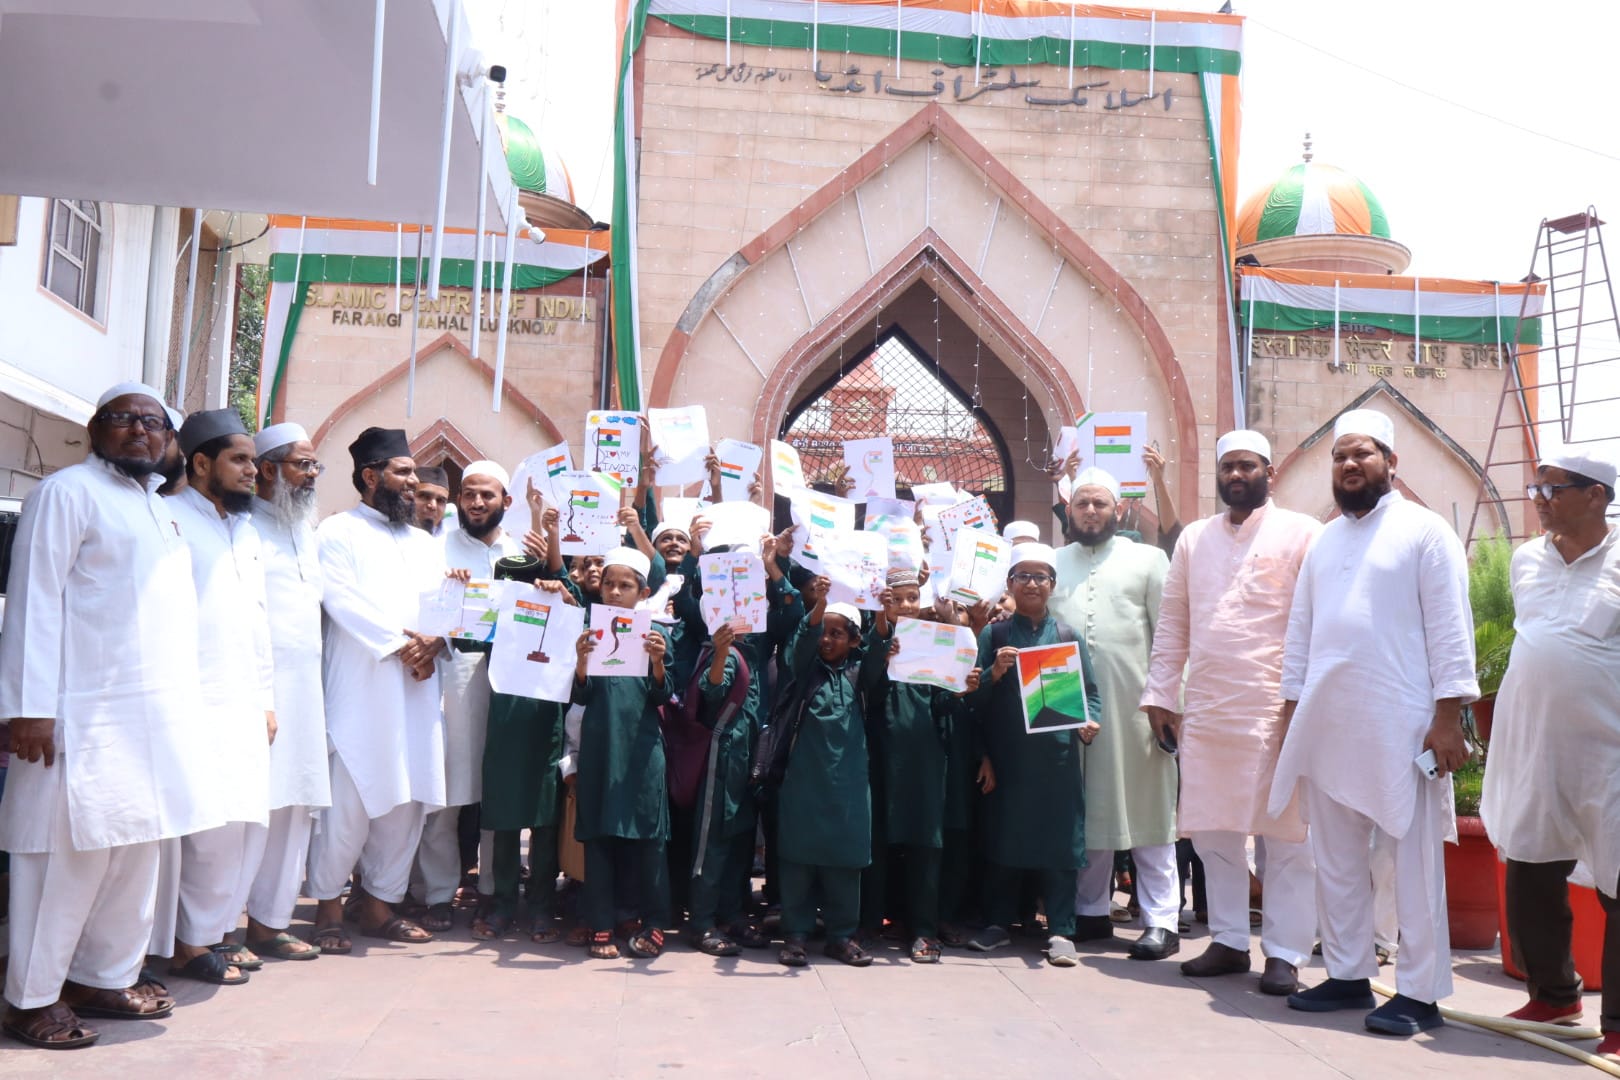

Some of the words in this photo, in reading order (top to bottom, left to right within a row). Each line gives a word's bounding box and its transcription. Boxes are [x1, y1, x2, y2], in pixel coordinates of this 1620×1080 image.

[304, 285, 387, 310] SLAMIC
[536, 296, 592, 321] INDIA
[332, 310, 402, 327] FARANGI
[480, 318, 559, 336] LUKNOW
[1366, 364, 1392, 378] महल
[1403, 365, 1447, 379] लखनऊ
[602, 462, 638, 473] INDIA
